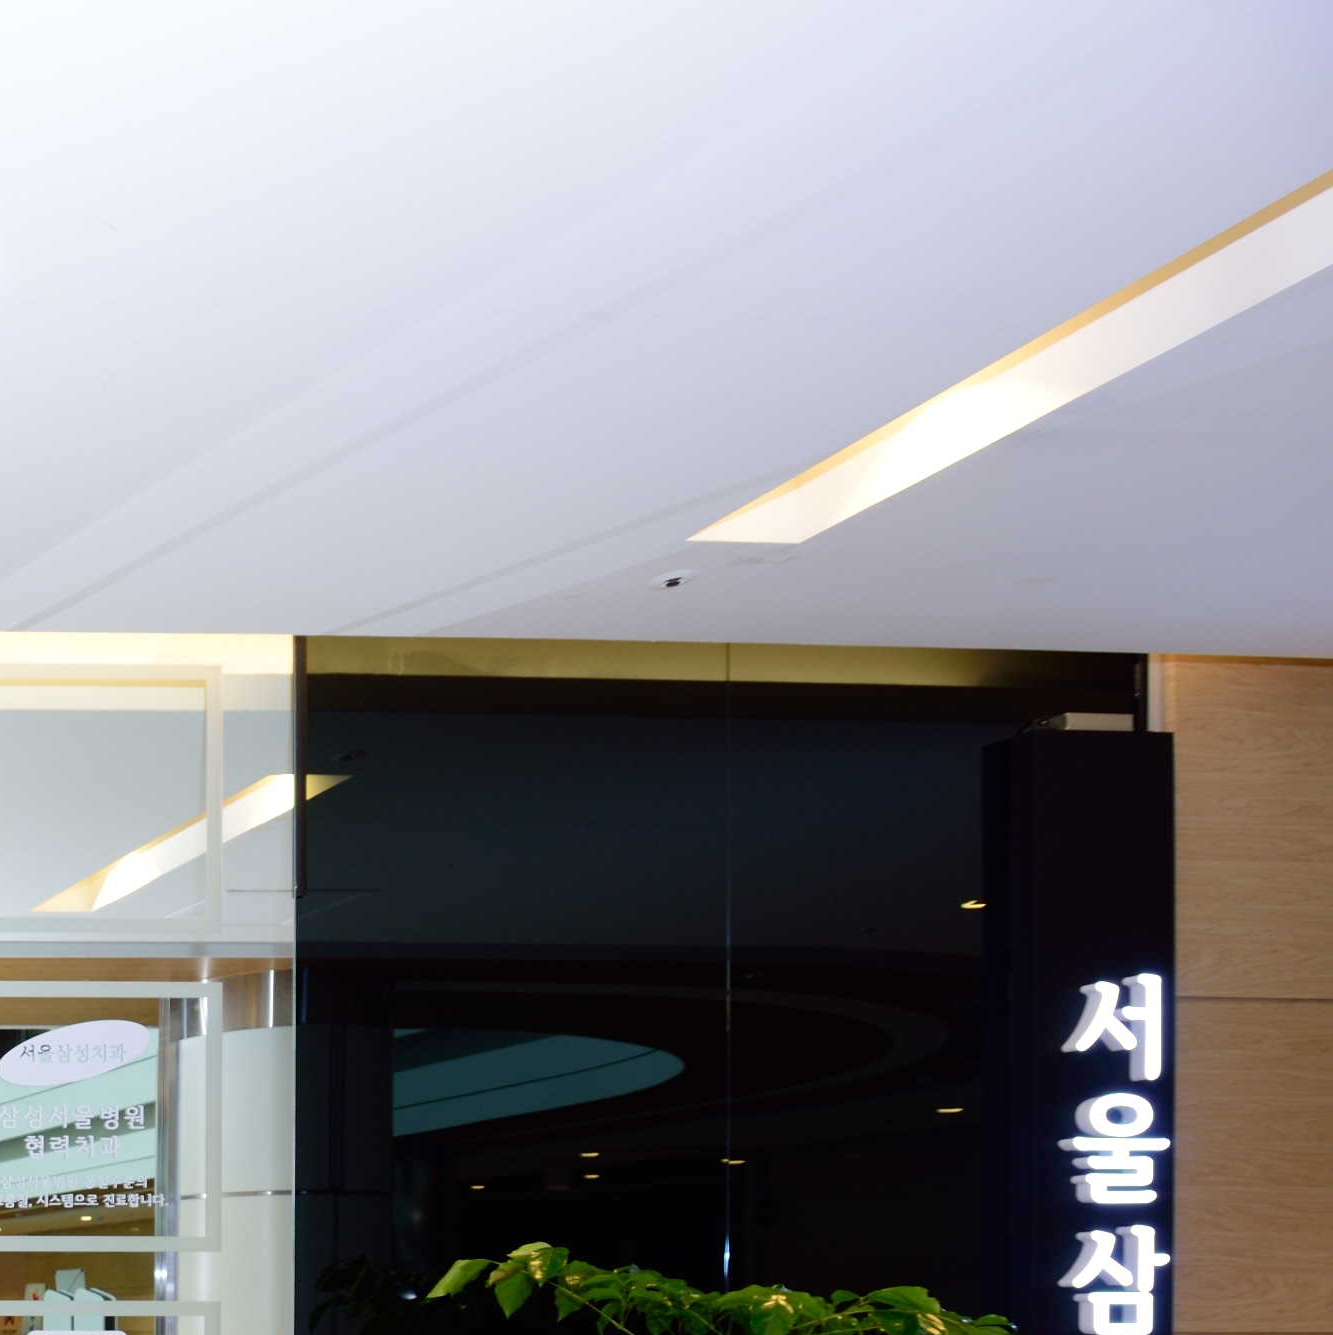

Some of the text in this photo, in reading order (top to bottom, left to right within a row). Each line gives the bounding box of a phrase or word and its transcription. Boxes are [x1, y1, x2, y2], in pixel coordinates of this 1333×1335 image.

[20, 1044, 126, 1063] 서울삼성치과
[24, 1134, 121, 1160] 협력치과
[1, 1174, 148, 1190] 삼성서울병원 동일수준의
[36, 1193, 99, 1208] 시스템으로
[102, 1193, 169, 1208] 진료합니다.
